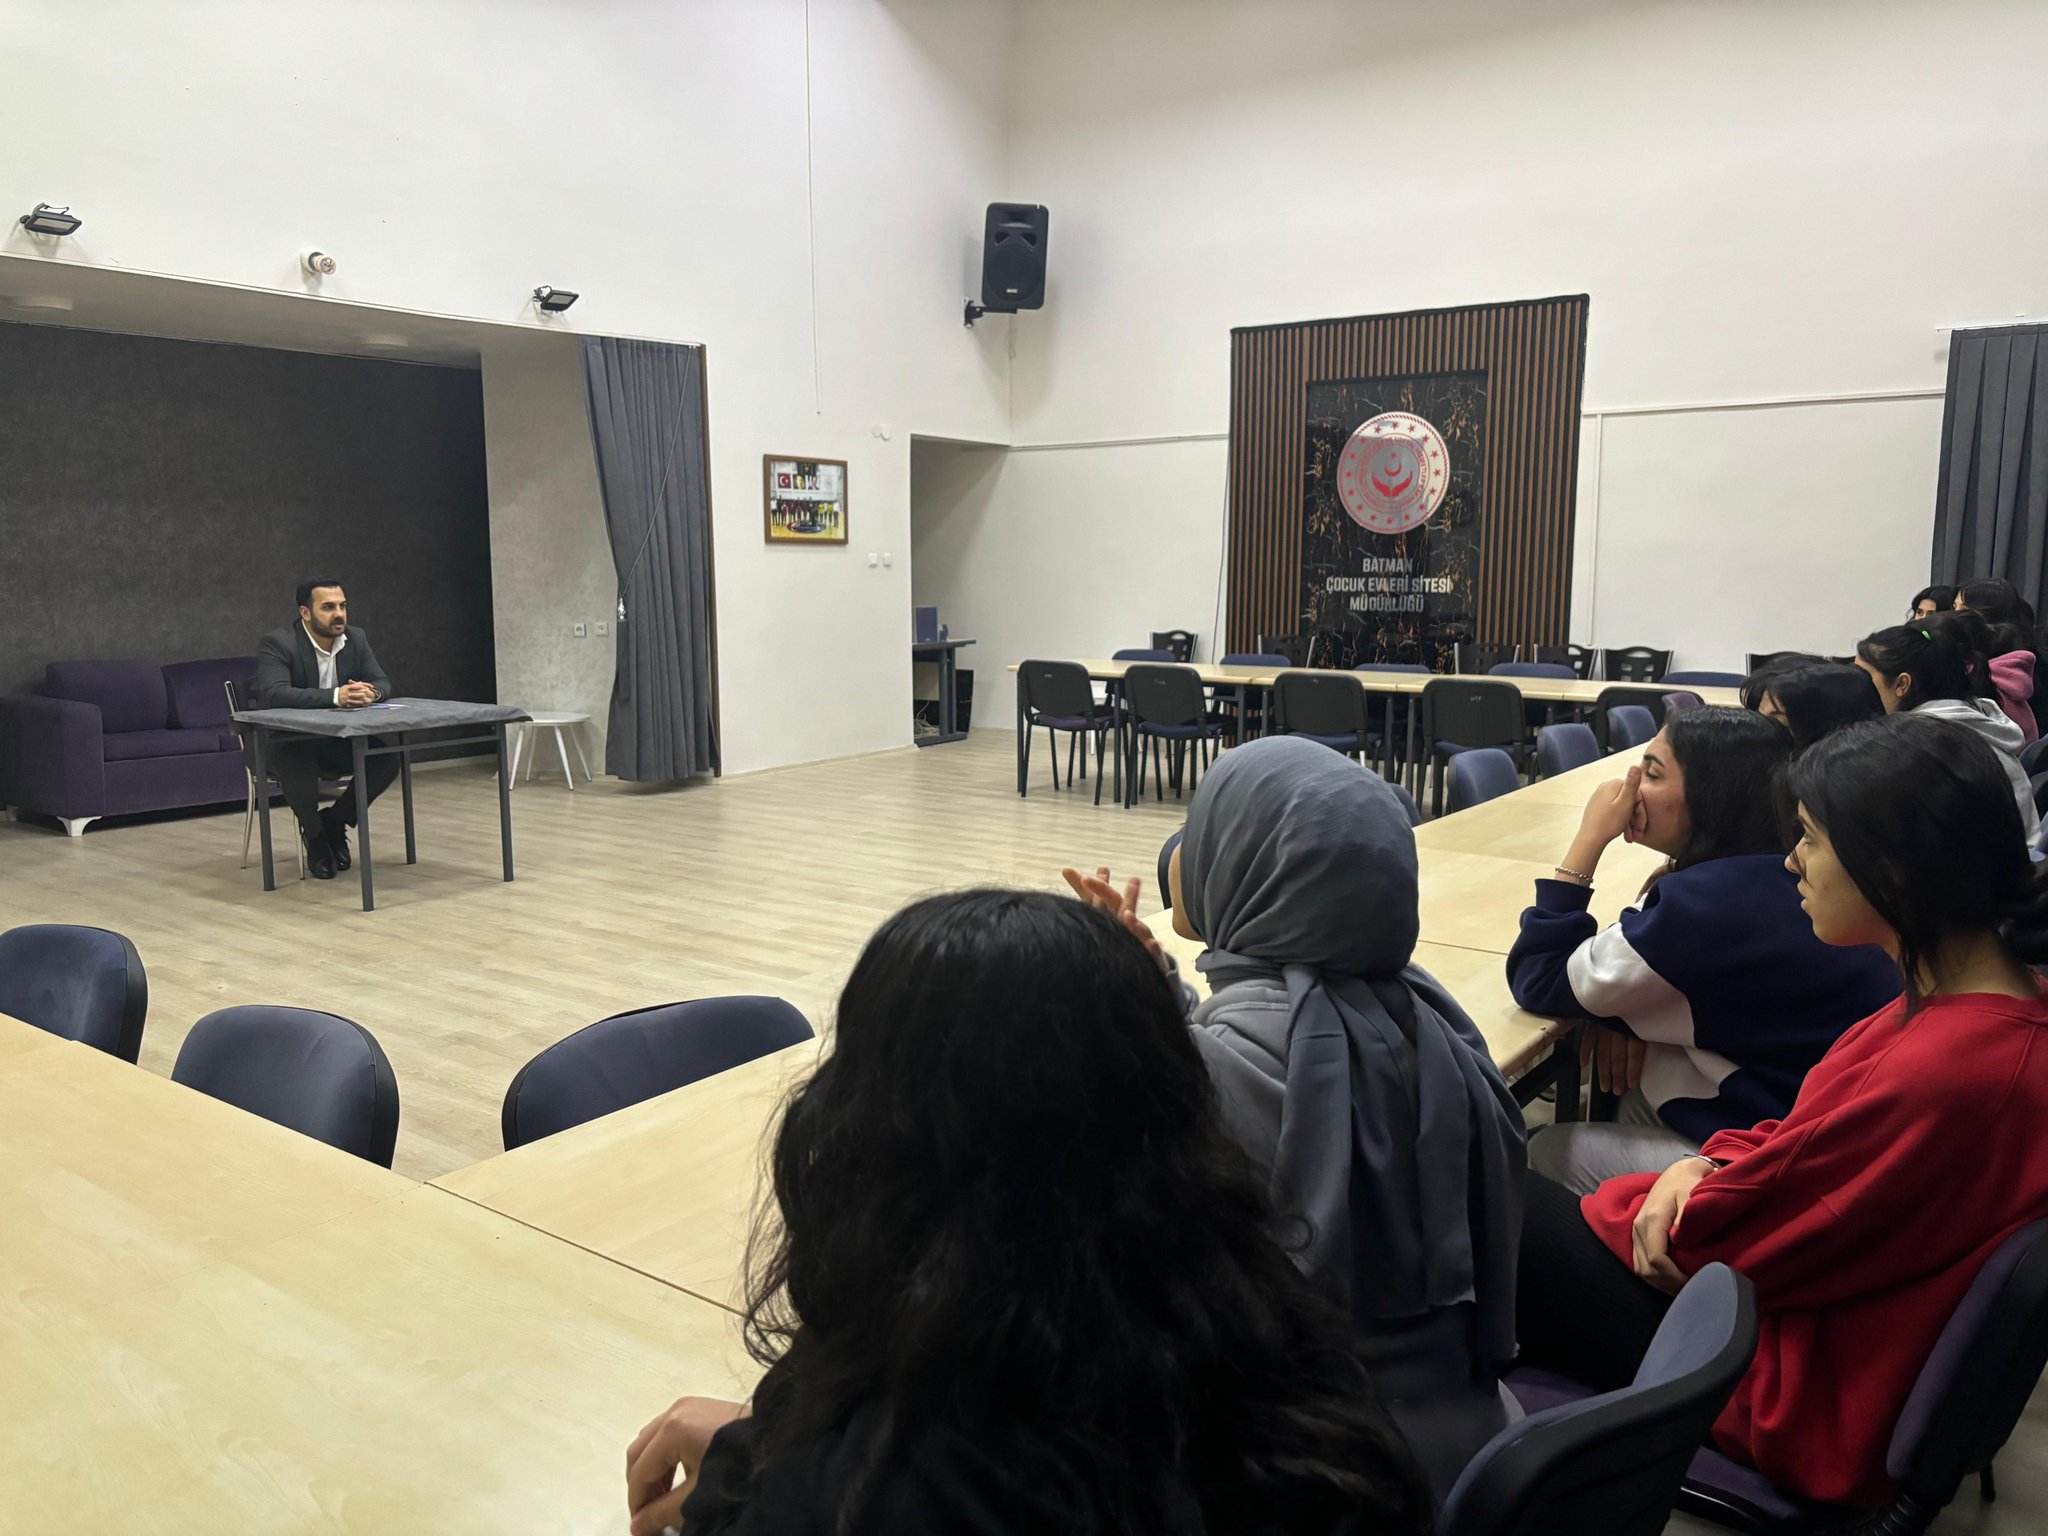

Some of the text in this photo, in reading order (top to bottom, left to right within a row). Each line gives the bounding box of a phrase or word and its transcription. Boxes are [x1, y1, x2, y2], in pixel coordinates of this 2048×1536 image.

[1362, 558, 1413, 573] BATMAN
[1326, 575, 1453, 594] ÇOCUK EVLERİ SİTESİ
